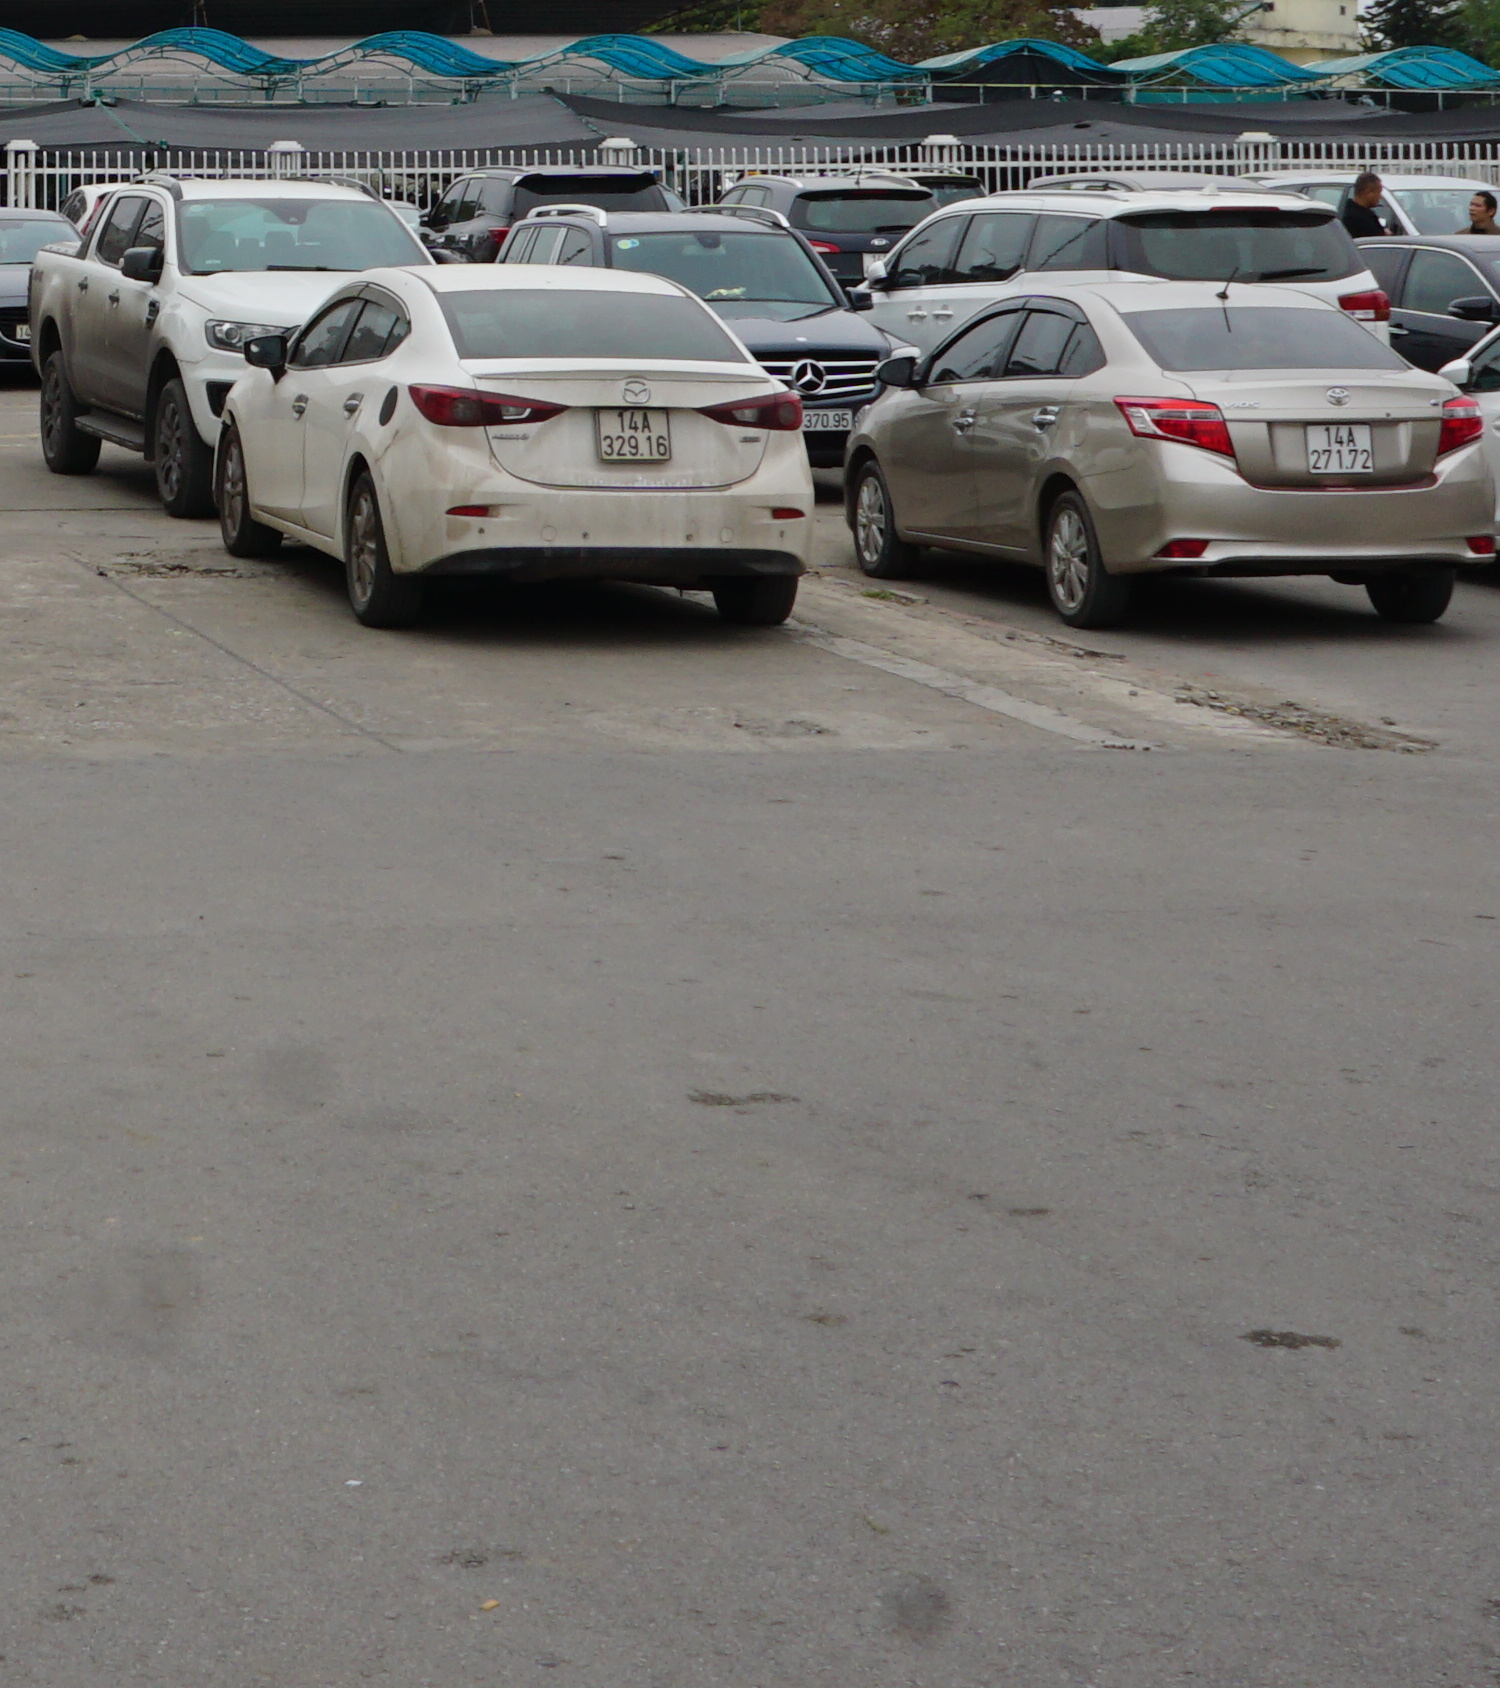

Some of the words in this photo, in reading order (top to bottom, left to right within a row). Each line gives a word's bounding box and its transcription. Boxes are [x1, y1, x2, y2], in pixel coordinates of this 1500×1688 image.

[617, 412, 652, 434] 14A
[602, 435, 668, 457] 329.16
[1324, 427, 1357, 448] 14A
[1310, 449, 1371, 471] 271.72
